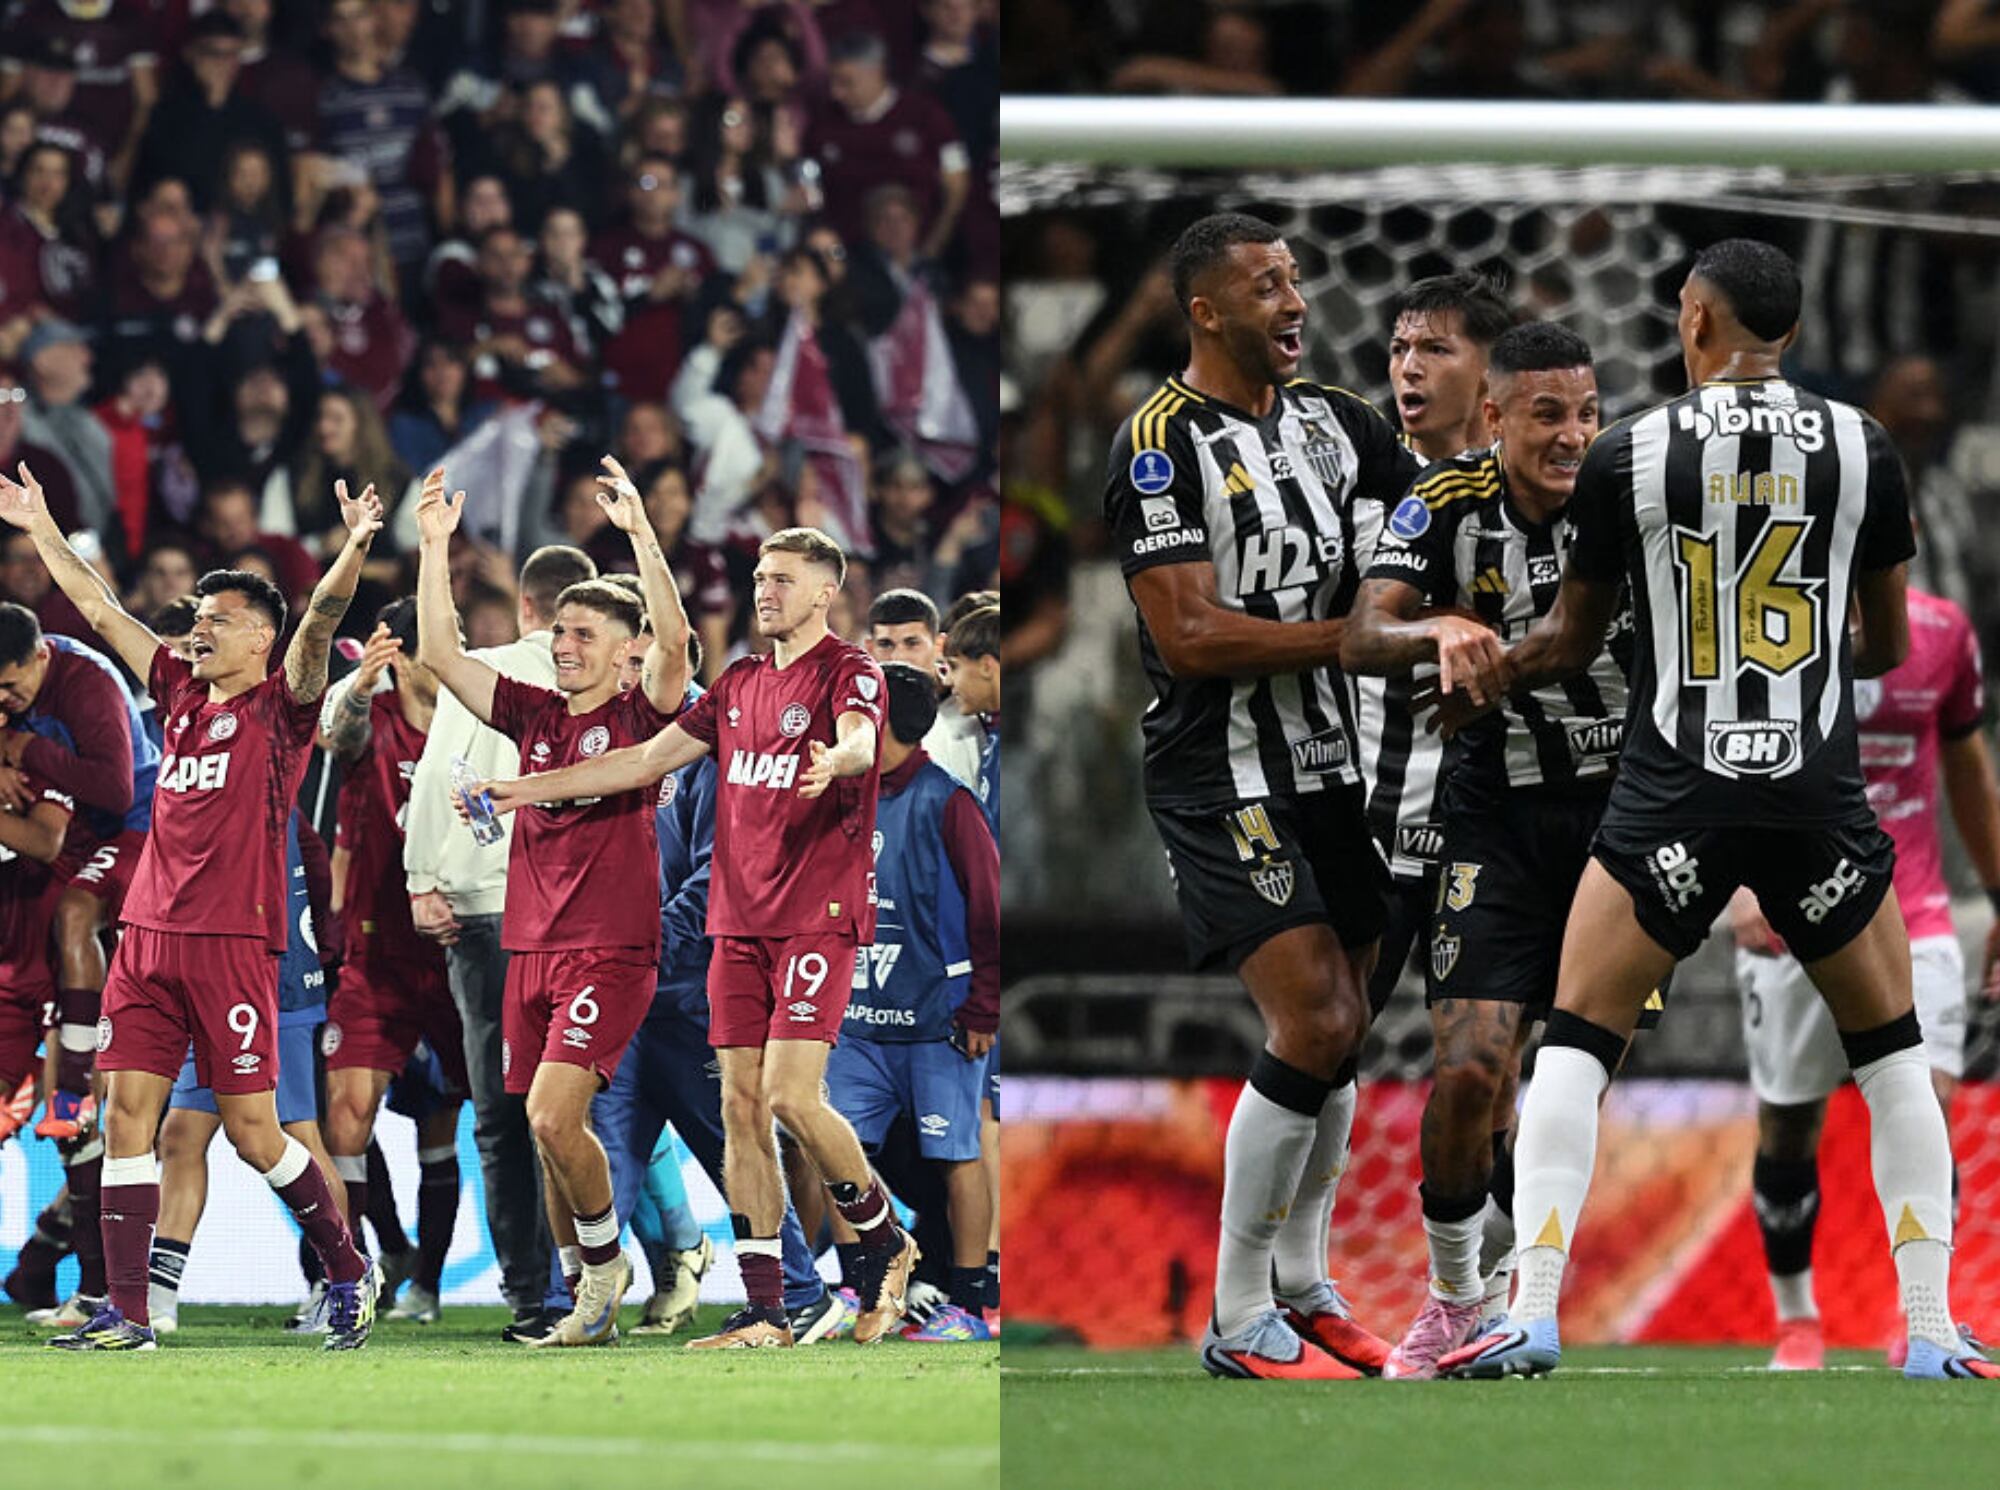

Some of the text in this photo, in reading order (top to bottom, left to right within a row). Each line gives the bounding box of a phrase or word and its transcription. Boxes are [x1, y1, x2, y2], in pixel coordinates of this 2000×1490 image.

[1717, 400, 1824, 452] bmg
[1133, 527, 1205, 554] GERDAU
[1671, 515, 1827, 686] 16
[727, 750, 800, 789] MAPEI
[1725, 733, 1780, 762] BH
[1226, 803, 1282, 861] 14
[1656, 842, 1704, 908] abc
[1798, 857, 1860, 925] abc
[783, 952, 829, 998] 19
[227, 1002, 259, 1050] 9
[569, 985, 600, 1026] 6
